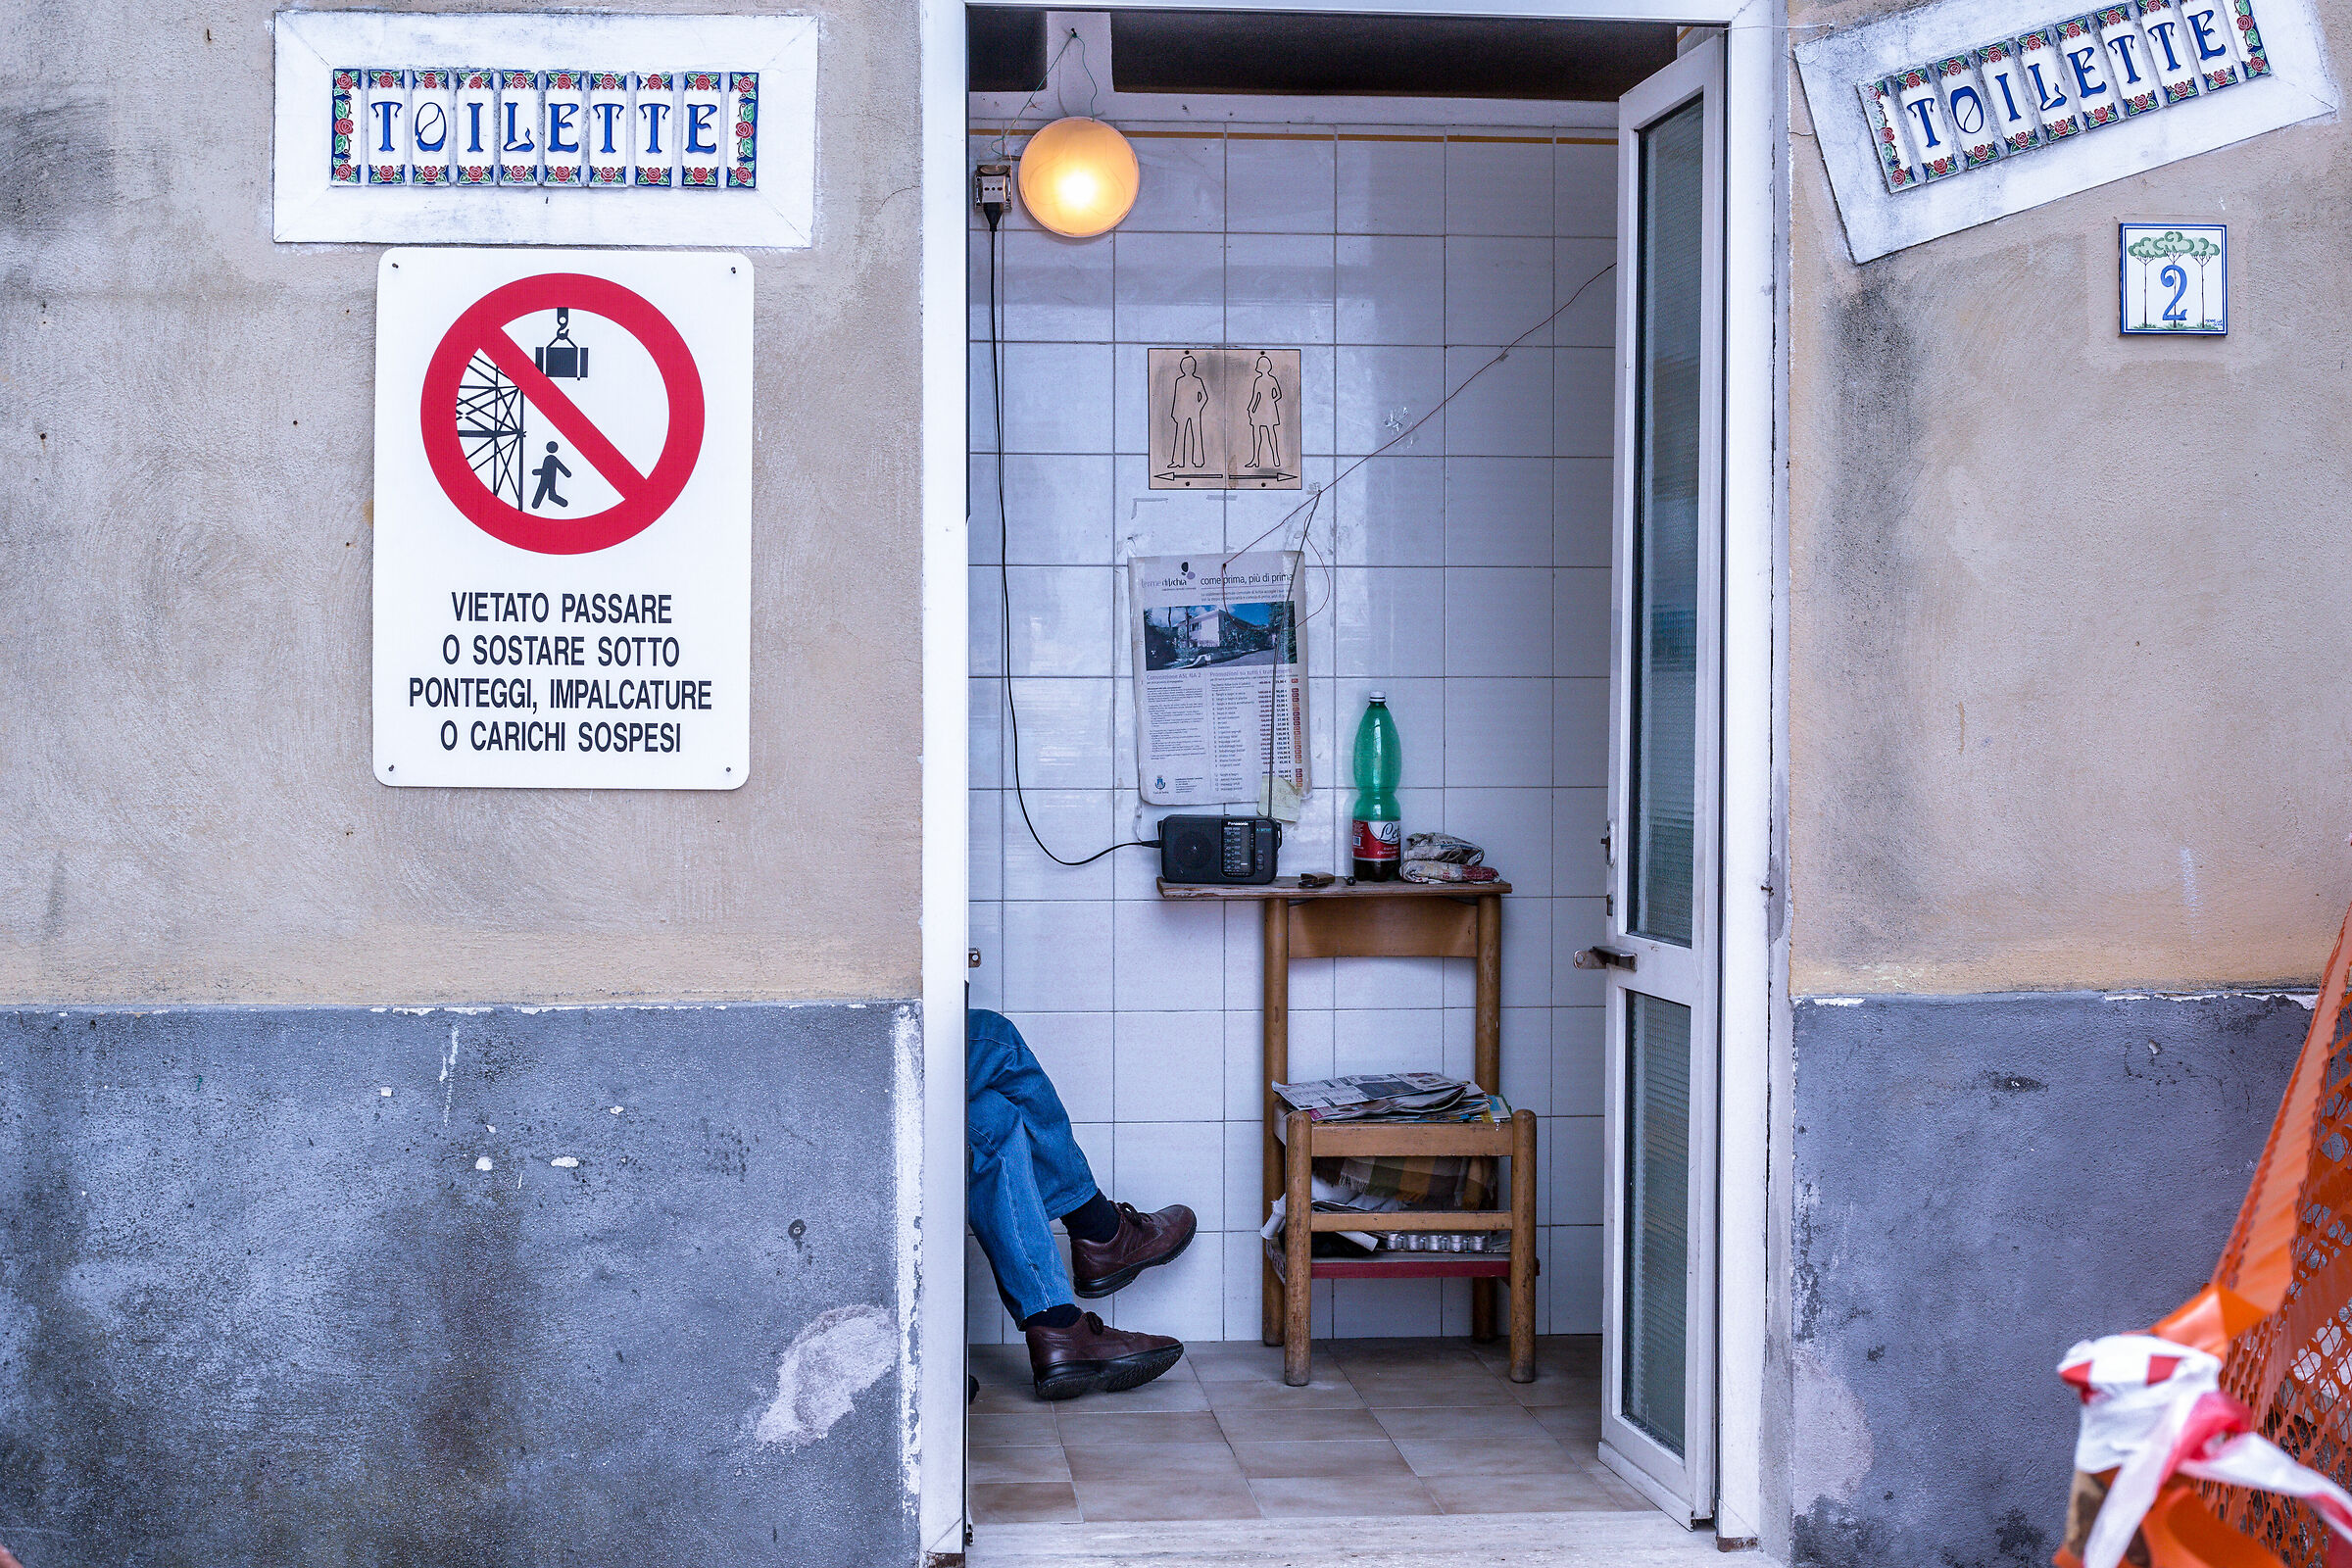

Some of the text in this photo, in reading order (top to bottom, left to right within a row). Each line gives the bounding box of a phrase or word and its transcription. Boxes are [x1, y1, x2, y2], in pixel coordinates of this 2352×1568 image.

[1906, 9, 2228, 149] TOILETTE
[370, 102, 718, 155] TOILETTE
[2160, 264, 2189, 322] 2
[1200, 571, 1294, 586] come prima, più di prima
[452, 592, 672, 623] VIETATO PASSARE
[443, 634, 680, 666] O SOSTARE SOTTO
[410, 677, 712, 714] PONTEGGI, IMPALCATURE
[441, 720, 681, 753] O CARICHI SOSPESI
